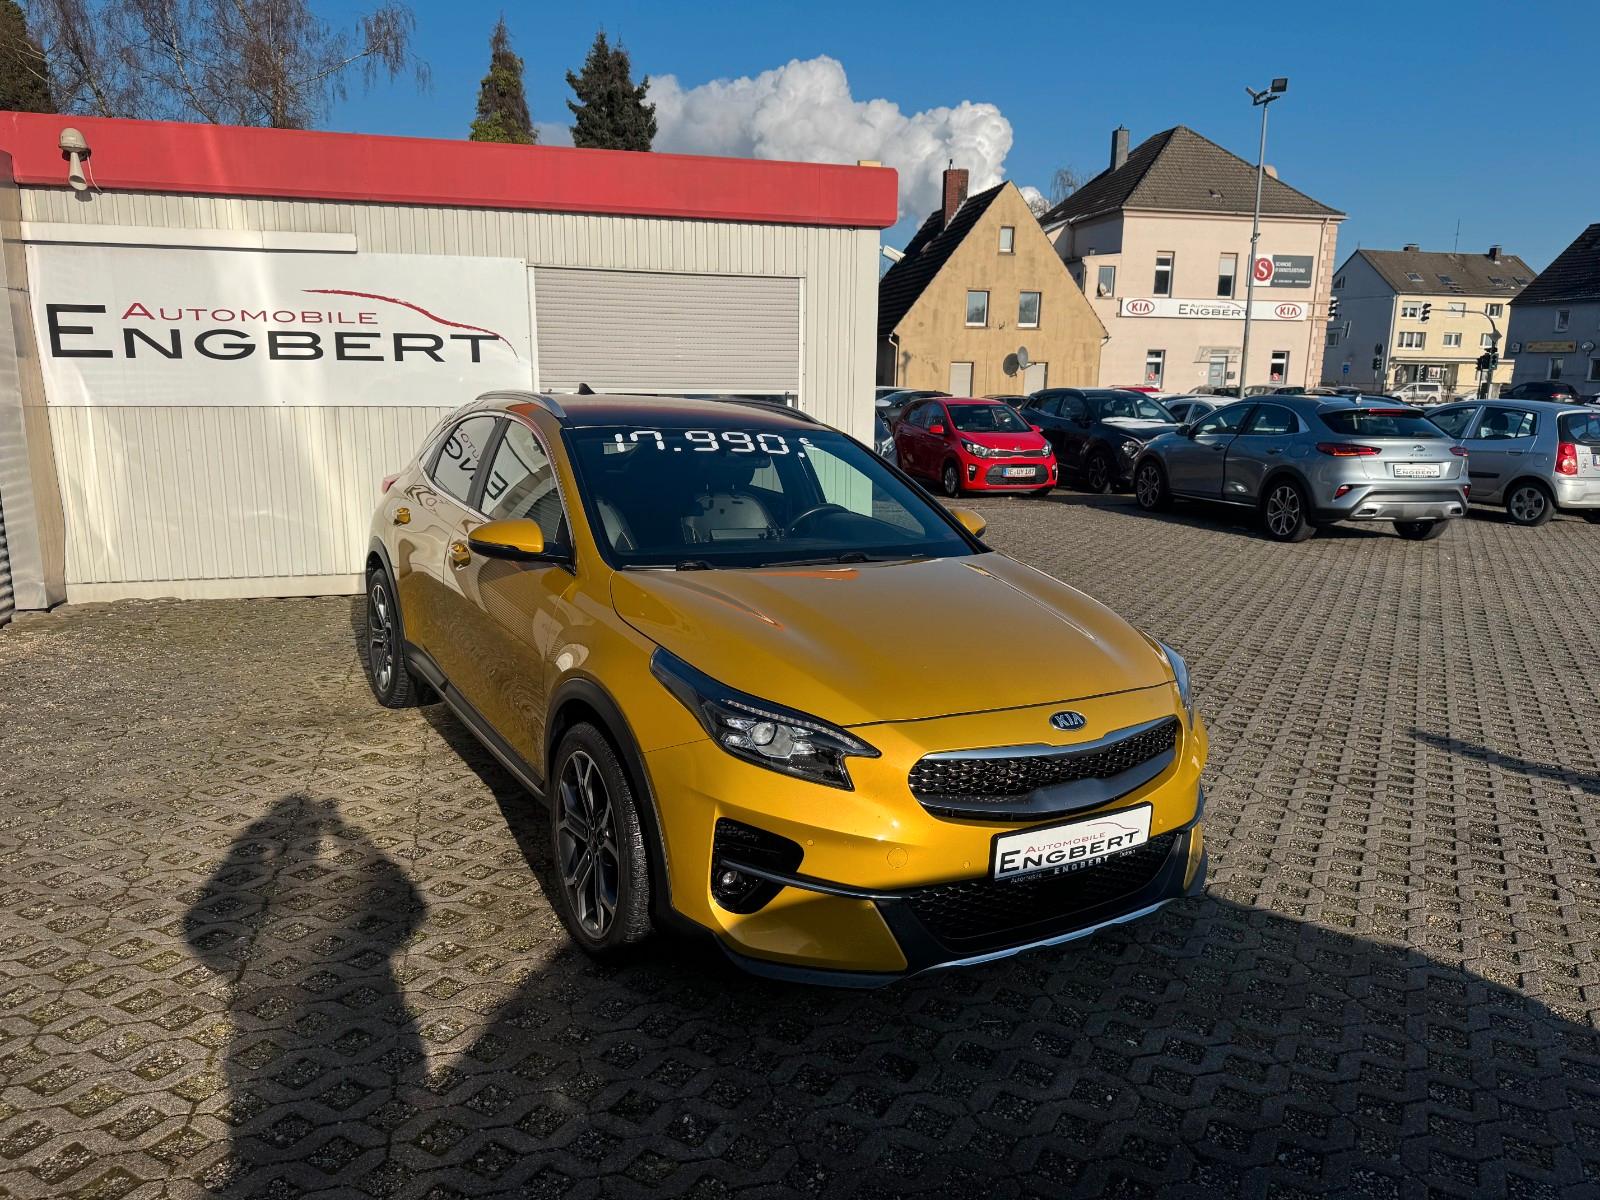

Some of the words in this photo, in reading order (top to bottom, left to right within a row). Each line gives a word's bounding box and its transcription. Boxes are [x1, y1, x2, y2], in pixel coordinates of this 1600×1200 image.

[120, 302, 378, 325] AUTOMOBILE
[1131, 302, 1150, 312] KIA
[1279, 306, 1297, 316] KIA
[46, 303, 500, 364] ENGBERT
[1055, 713, 1084, 728] KIA
[998, 829, 1140, 874] ENGBERT
[1025, 831, 1106, 855] AUTOMOBILE
[1054, 855, 1110, 875] ENGBERT
